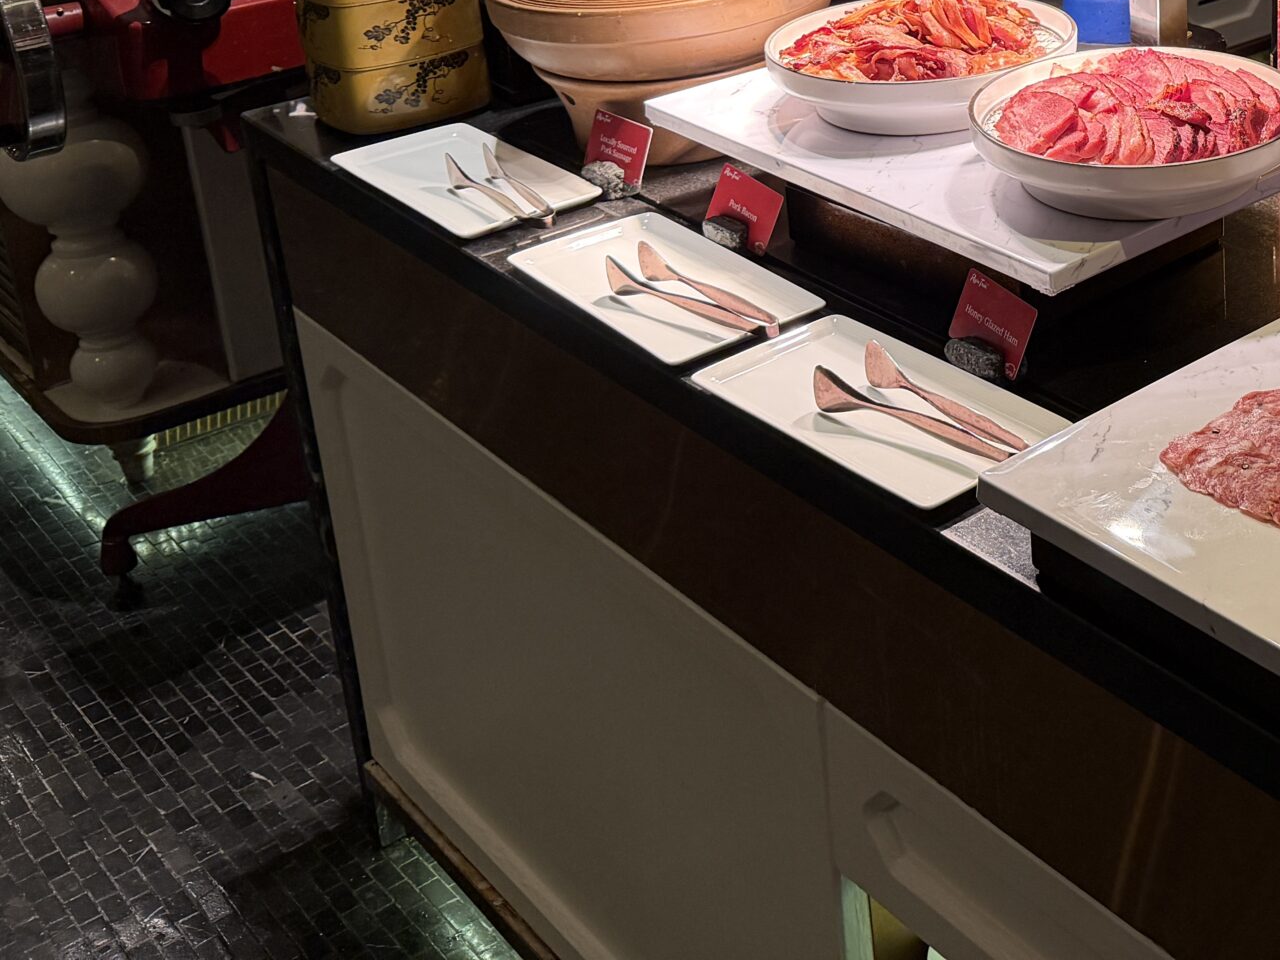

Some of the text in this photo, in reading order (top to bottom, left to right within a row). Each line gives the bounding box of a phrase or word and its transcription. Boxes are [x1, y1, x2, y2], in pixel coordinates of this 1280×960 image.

[600, 144, 613, 155] Pork
[728, 198, 758, 223] Pork Bacon
[965, 303, 1019, 347] Honey Glazed Ham
